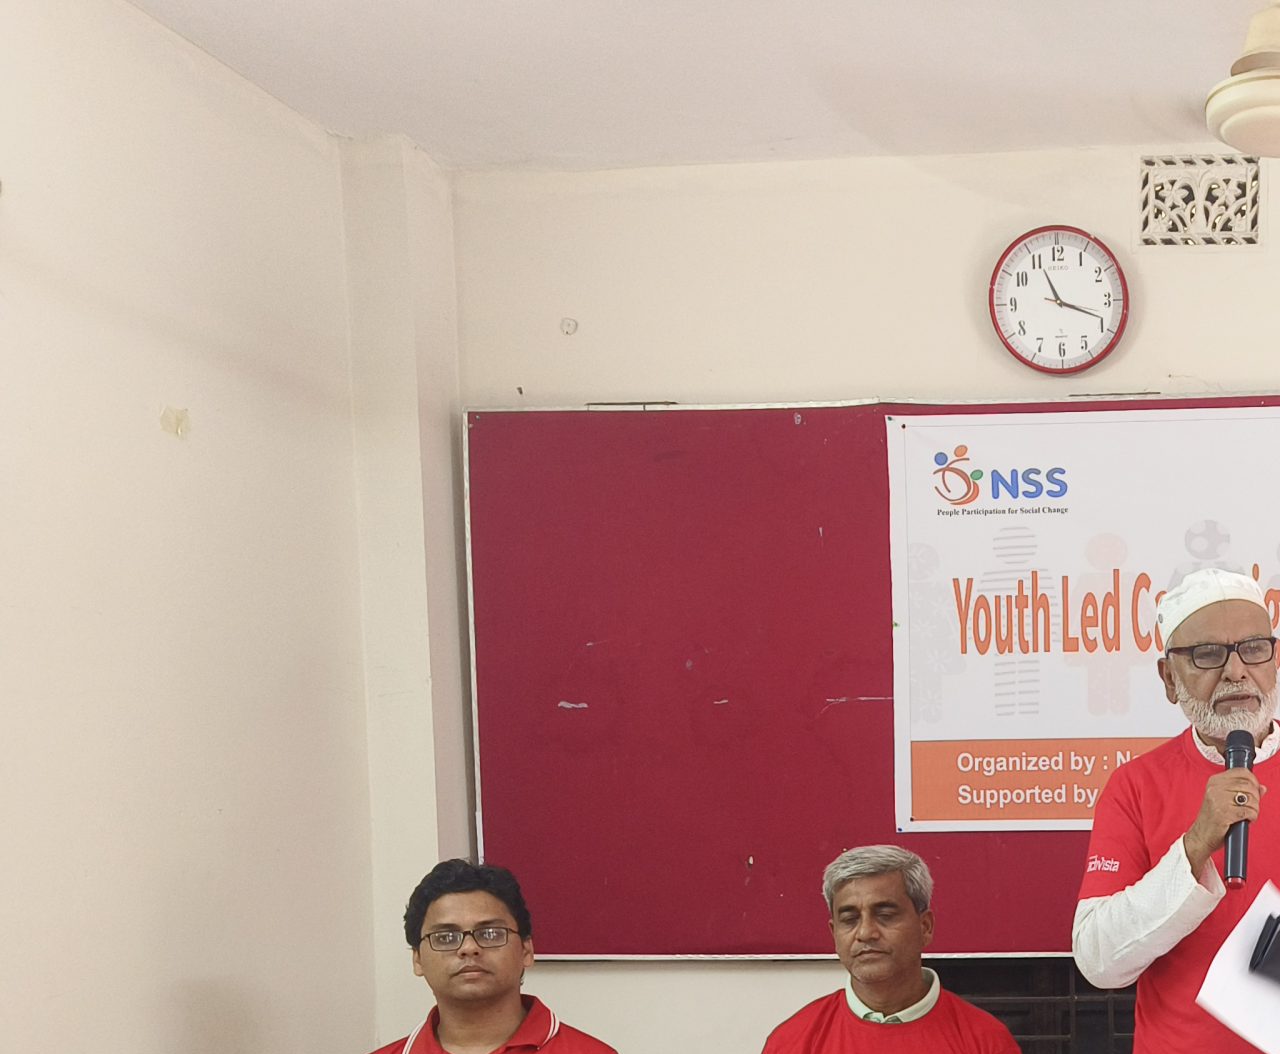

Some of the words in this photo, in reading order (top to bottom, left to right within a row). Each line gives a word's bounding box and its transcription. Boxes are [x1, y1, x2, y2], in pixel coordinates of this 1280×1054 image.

[1032, 253, 1042, 270] 11
[1051, 245, 1064, 262] 12
[1079, 251, 1083, 267] 1
[1016, 271, 1028, 287] 10
[1094, 266, 1103, 283] 2
[1009, 297, 1017, 312] 9
[1103, 292, 1111, 308] 3
[1018, 320, 1026, 336] 8
[1036, 337, 1044, 353] 7
[1058, 341, 1066, 357] 6
[1080, 335, 1088, 351] 5
[990, 467, 1069, 500] NSS
[937, 509, 960, 518] People
[961, 508, 1006, 517] Participation
[1008, 506, 1018, 515] for
[1020, 506, 1041, 515] Social
[1042, 505, 1069, 514] Change
[952, 570, 1051, 656] Youth
[1061, 568, 1121, 653] Led
[957, 751, 1064, 776] Organized
[1070, 751, 1096, 776] by
[958, 783, 1067, 809] Supported
[1073, 783, 1099, 808] by
